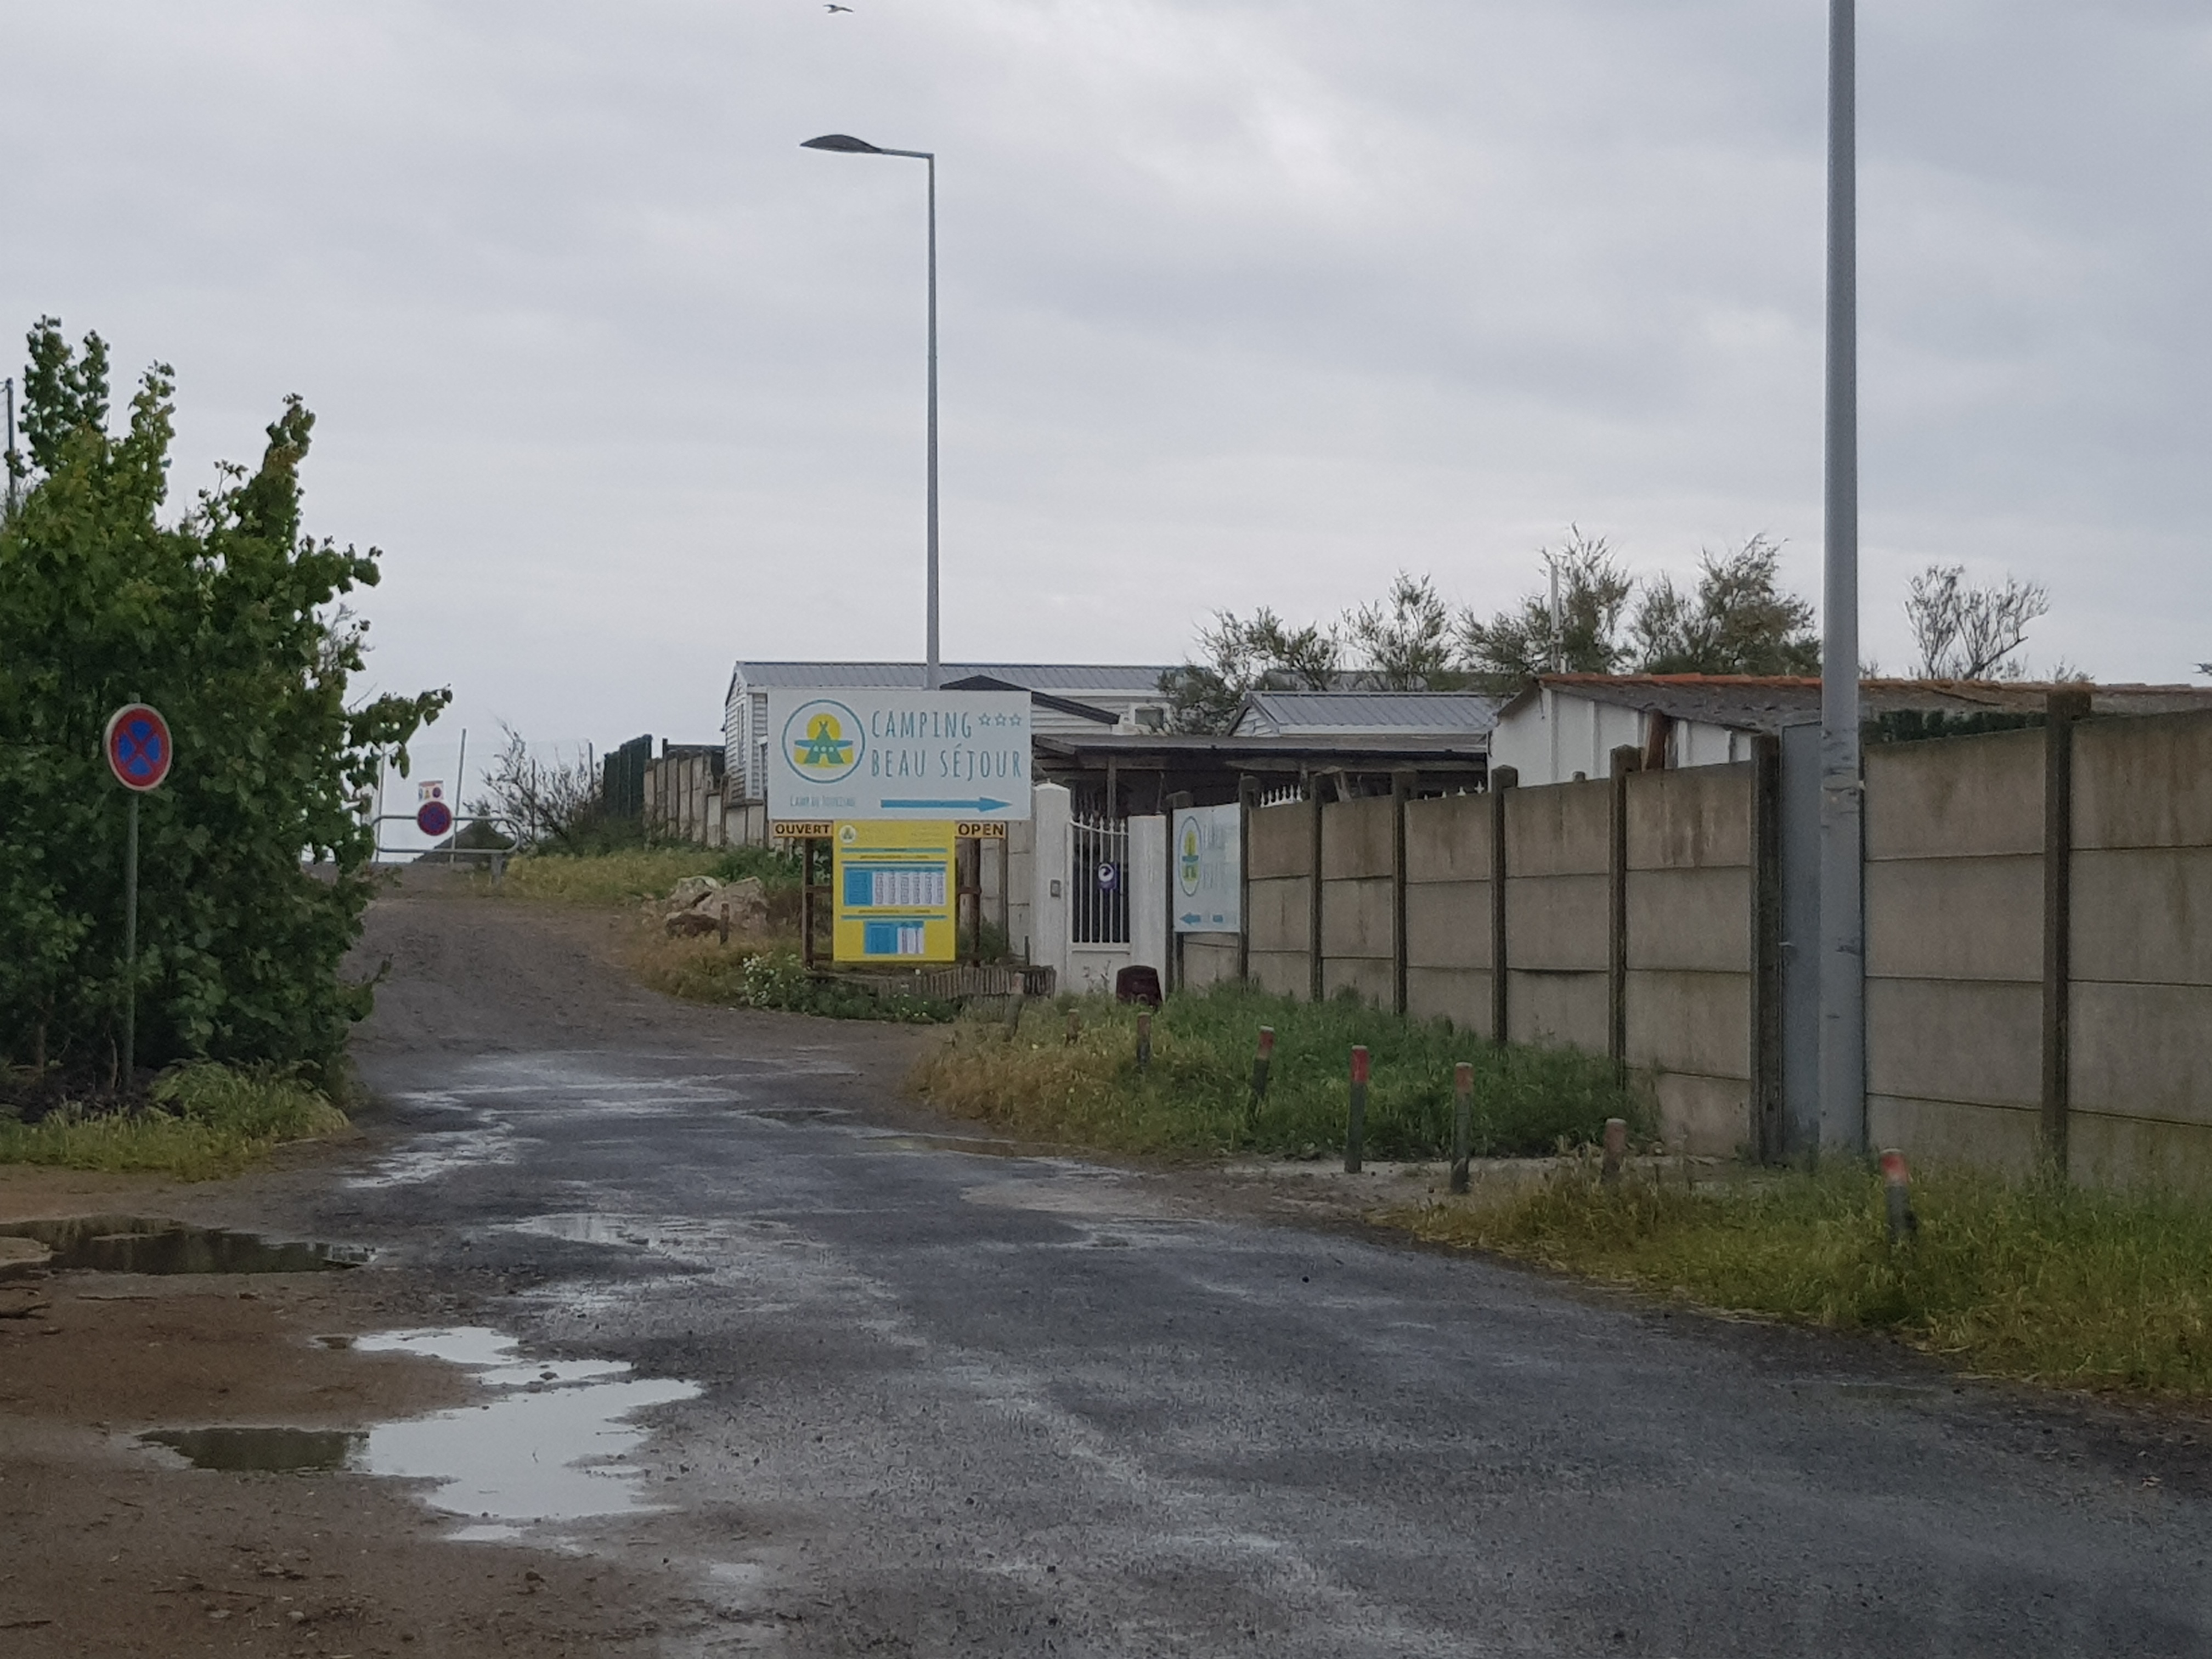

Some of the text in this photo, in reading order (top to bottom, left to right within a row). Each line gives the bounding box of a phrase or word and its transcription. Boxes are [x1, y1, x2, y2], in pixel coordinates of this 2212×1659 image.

[872, 710, 972, 738] CAMPING
[871, 742, 1022, 782] BEAU SÉJOUR
[775, 823, 831, 834] OUVERT
[958, 822, 1004, 836] OPEN
